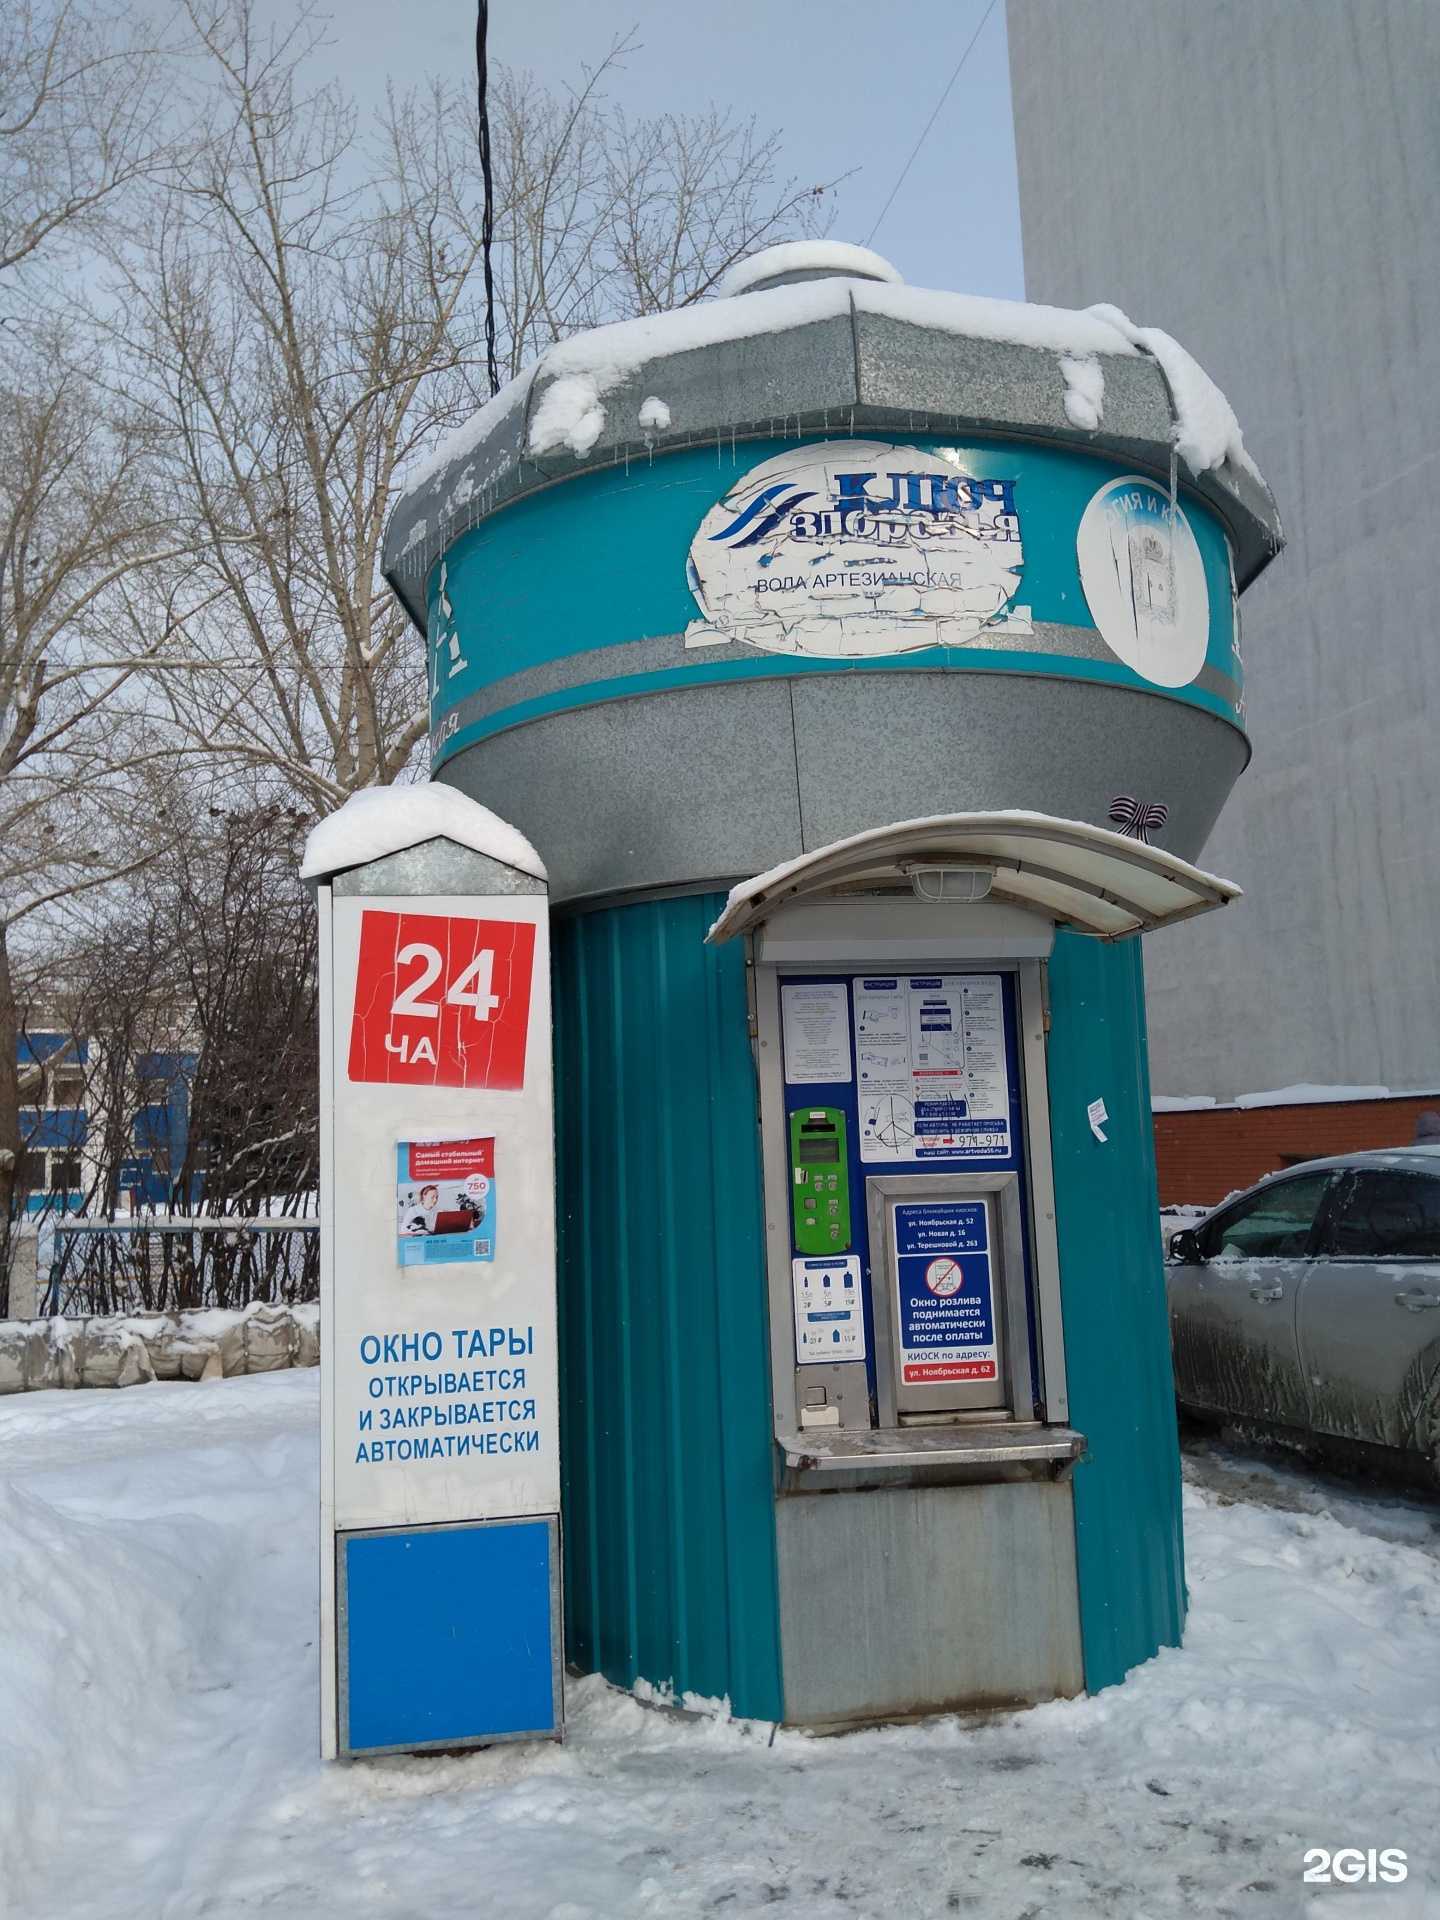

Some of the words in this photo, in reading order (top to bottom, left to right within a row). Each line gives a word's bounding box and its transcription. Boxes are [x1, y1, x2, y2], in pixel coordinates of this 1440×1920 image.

[390, 942, 500, 1022] 24
[384, 1032, 438, 1066] ЧА
[467, 1182, 486, 1190] 750
[910, 1298, 937, 1308] Окно
[939, 1297, 982, 1308] розлива
[912, 1308, 981, 1320] поднимается
[908, 1319, 986, 1331] автоматически
[912, 1333, 943, 1343] после
[945, 1331, 983, 1341] оплаты
[360, 1331, 443, 1365] ОКНО
[452, 1326, 533, 1359] ТАРЫ
[907, 1352, 940, 1361] КИОСК
[955, 1350, 991, 1360] адресу:
[908, 1370, 921, 1379] ул.
[922, 1367, 970, 1378] Ноябрьская
[971, 1367, 978, 1375] д.
[980, 1365, 991, 1374] 62
[369, 1368, 526, 1398] ОТКРЫВАЕТСЯ
[359, 1409, 372, 1431] И
[379, 1399, 536, 1430] ЗАКРЫВАЕТСЯ
[355, 1430, 540, 1464] АВТОМАТИЧЕСКИ
